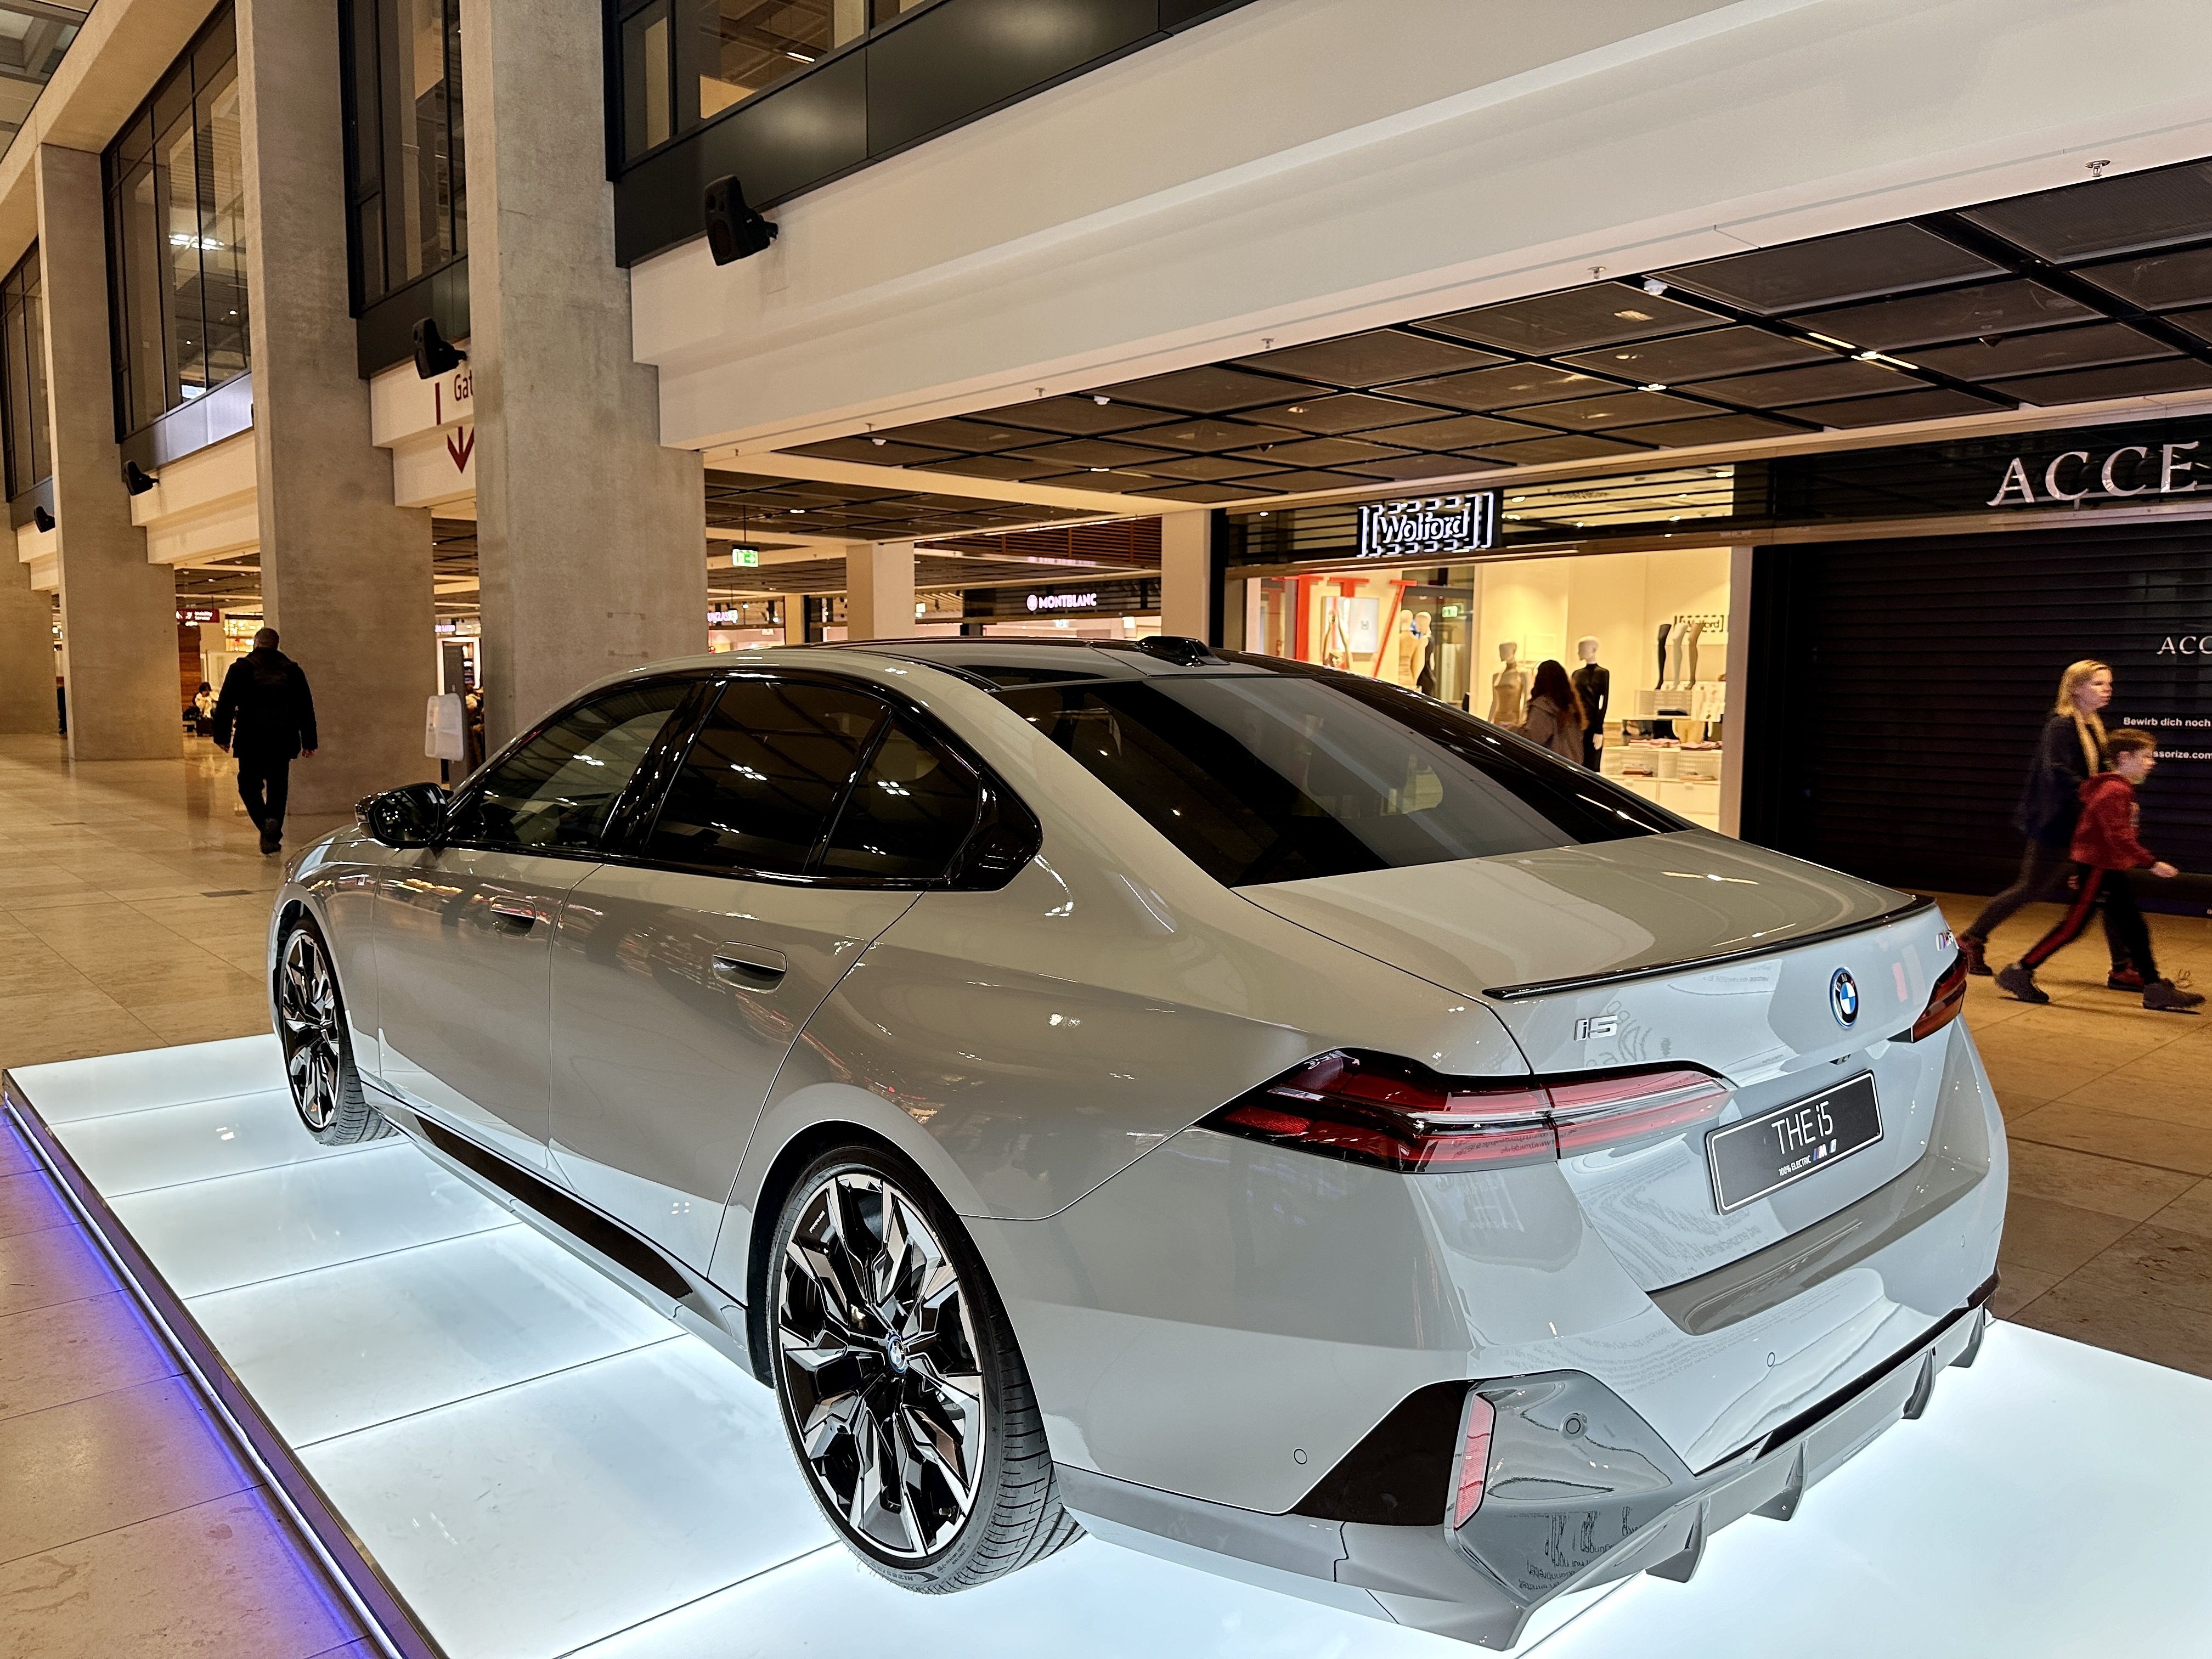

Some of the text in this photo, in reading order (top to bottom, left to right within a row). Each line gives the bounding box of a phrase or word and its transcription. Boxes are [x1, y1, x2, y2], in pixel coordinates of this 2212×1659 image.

[1986, 441, 2199, 506] ACCE
[1378, 511, 1470, 544] Wolford
[1039, 593, 1097, 608] MONTBLANC
[2156, 636, 2212, 654] ACC
[2123, 717, 2211, 727] Bewirb dich noch
[1574, 1014, 1618, 1041] i5
[1771, 1101, 1833, 1154] THE i5
[1778, 1164, 1791, 1176] 100%
[1791, 1155, 1812, 1171] ELECTRIC
